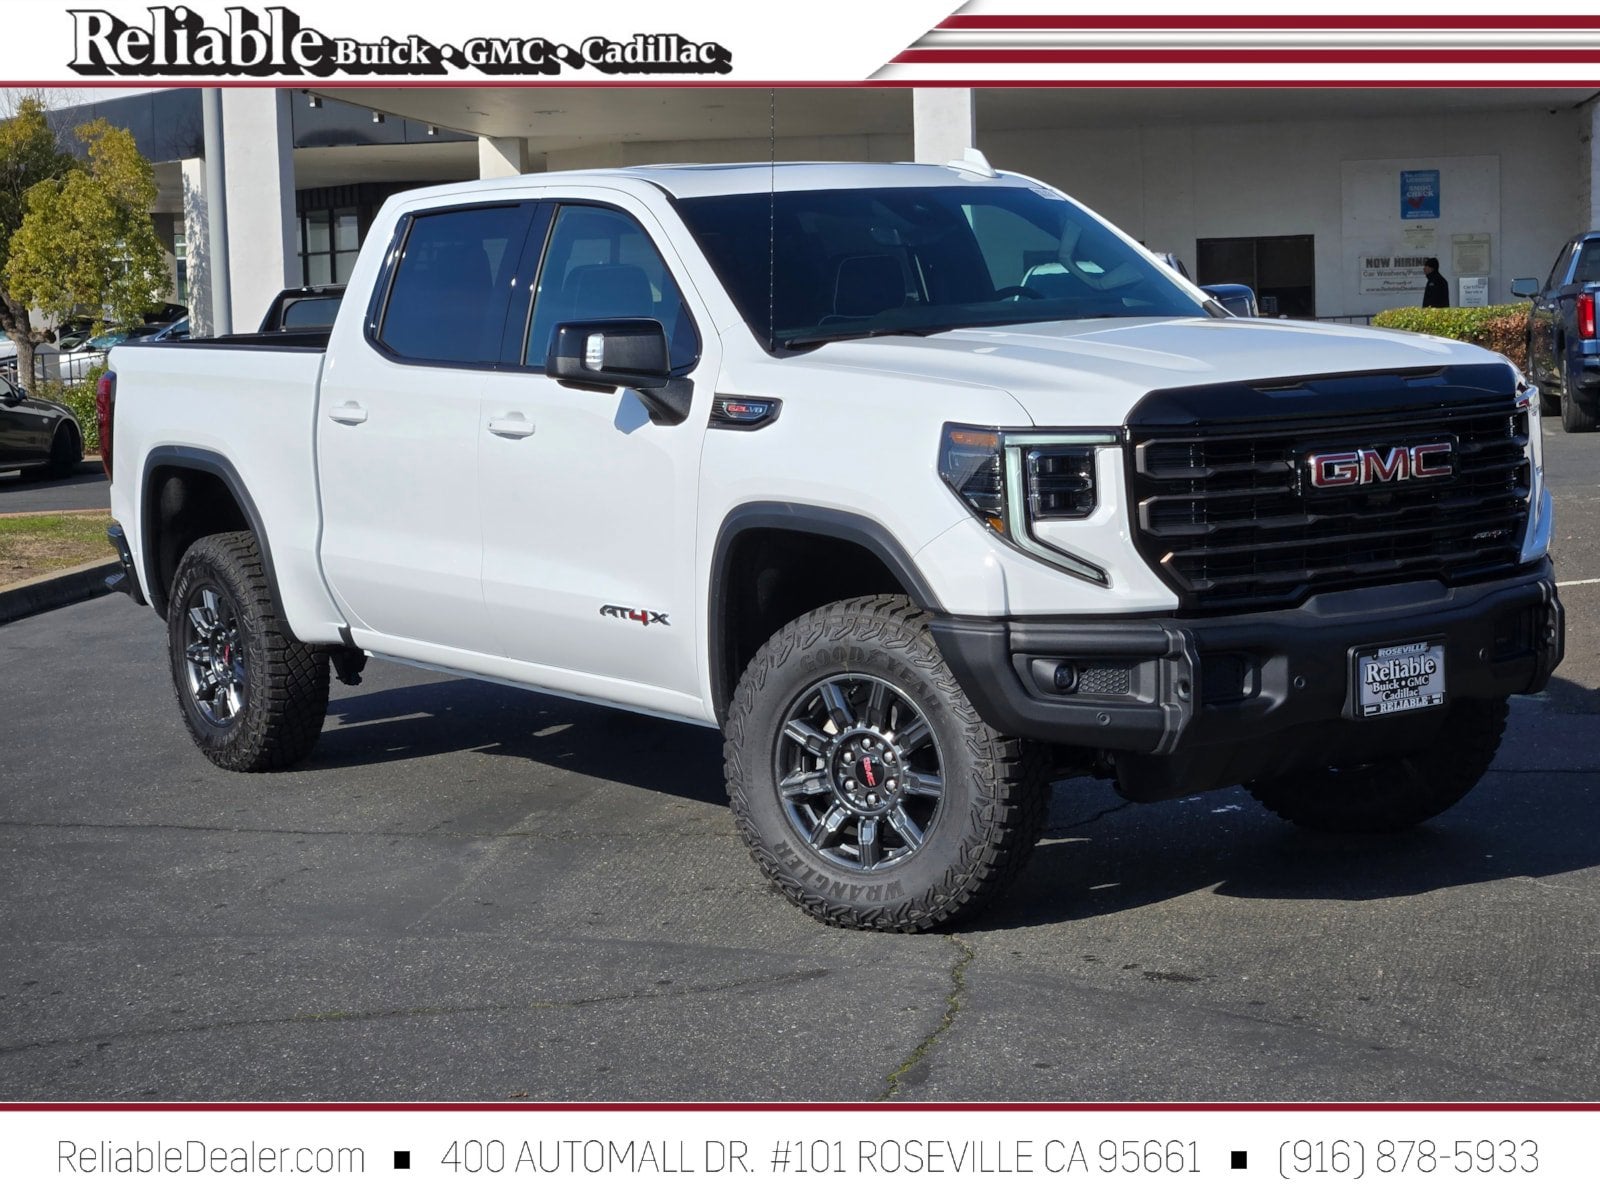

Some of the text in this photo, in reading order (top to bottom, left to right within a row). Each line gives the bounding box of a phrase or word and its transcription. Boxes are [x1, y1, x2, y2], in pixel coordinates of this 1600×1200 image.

[1366, 257, 1391, 268] NOW
[1309, 442, 1453, 489] GMC
[599, 604, 671, 627] AT4X
[1378, 643, 1428, 658] ROSEVILLE
[1365, 654, 1437, 684] Reliable
[1372, 675, 1430, 694] Buick GMC
[1381, 686, 1419, 702] Cadillac
[1380, 695, 1429, 713] RELIABLE
[774, 840, 905, 900] WRANGLER
